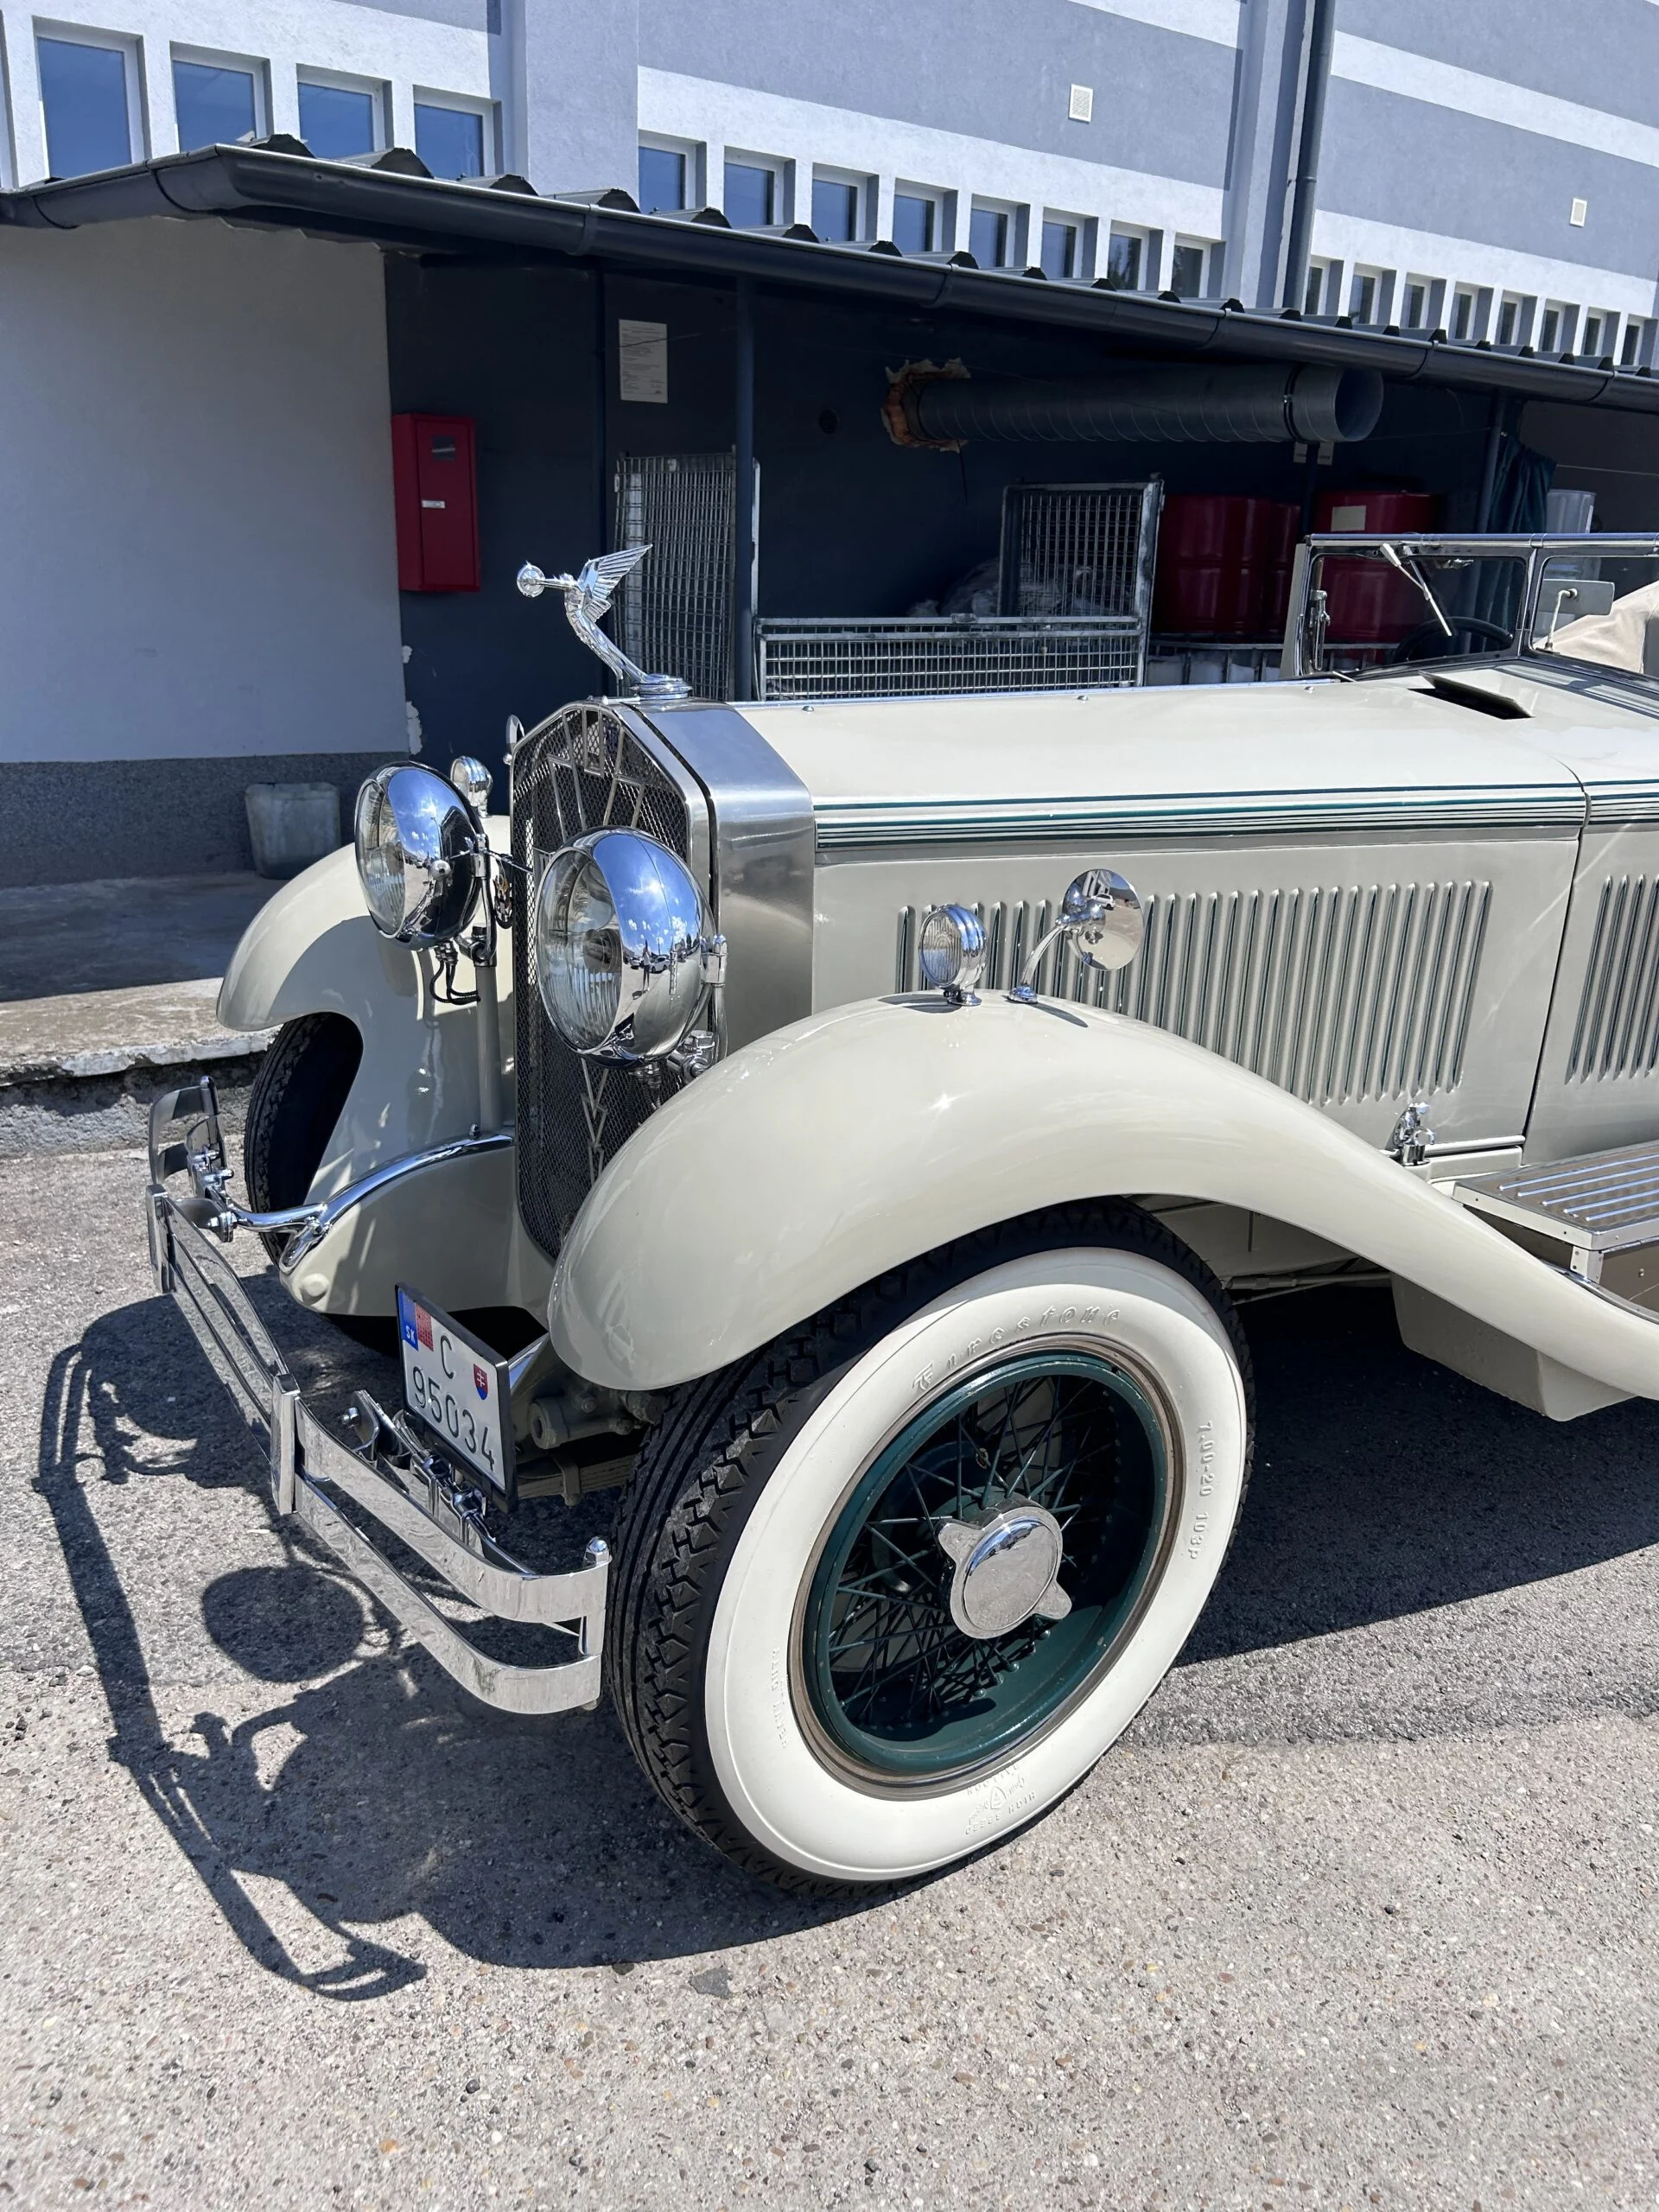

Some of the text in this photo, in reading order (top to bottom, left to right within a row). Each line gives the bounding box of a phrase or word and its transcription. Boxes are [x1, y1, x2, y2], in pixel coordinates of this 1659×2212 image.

[405, 1325, 416, 1344] SK
[440, 1335, 455, 1380] C
[912, 1305, 1121, 1390] Firestone
[412, 1366, 495, 1471] 95034
[1198, 1420, 1215, 1497] 7.00-20
